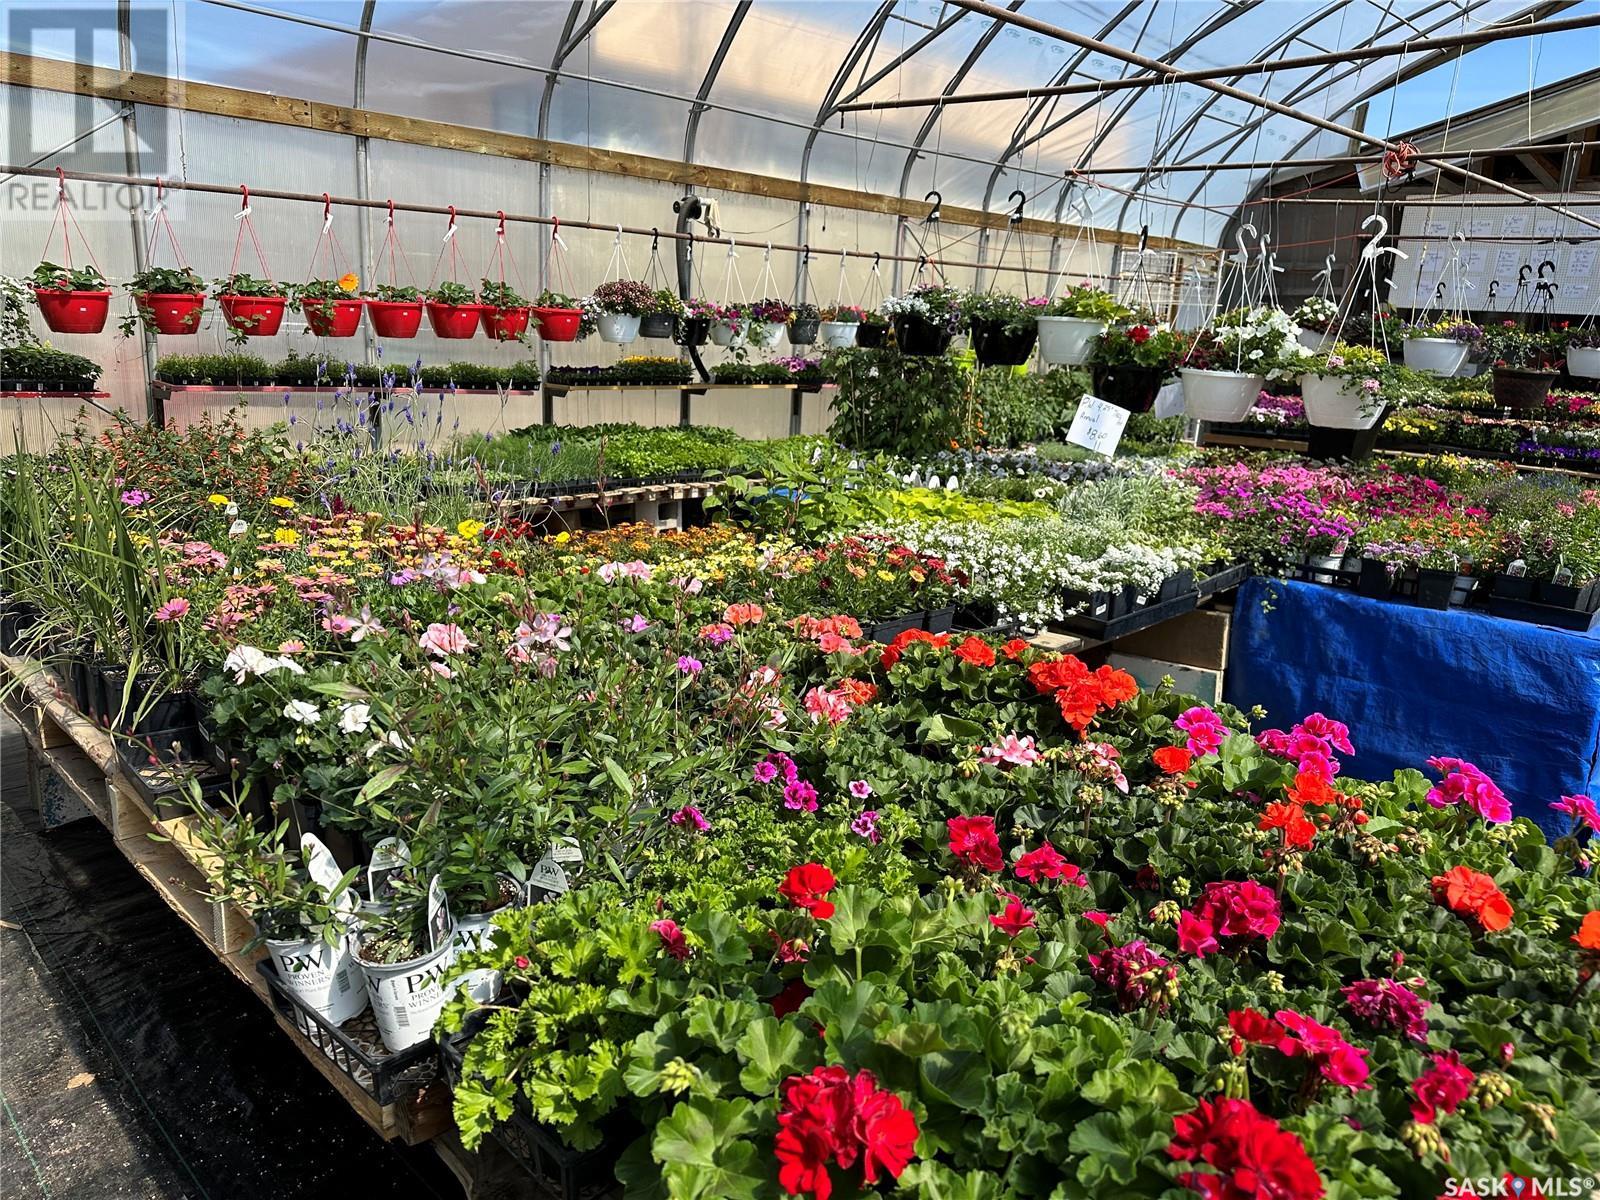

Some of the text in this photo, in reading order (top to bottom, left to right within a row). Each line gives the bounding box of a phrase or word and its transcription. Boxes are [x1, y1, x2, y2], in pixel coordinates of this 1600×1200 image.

[279, 949, 325, 973] PW
[287, 970, 325, 980] PROVEN
[411, 984, 440, 1001] PROV
